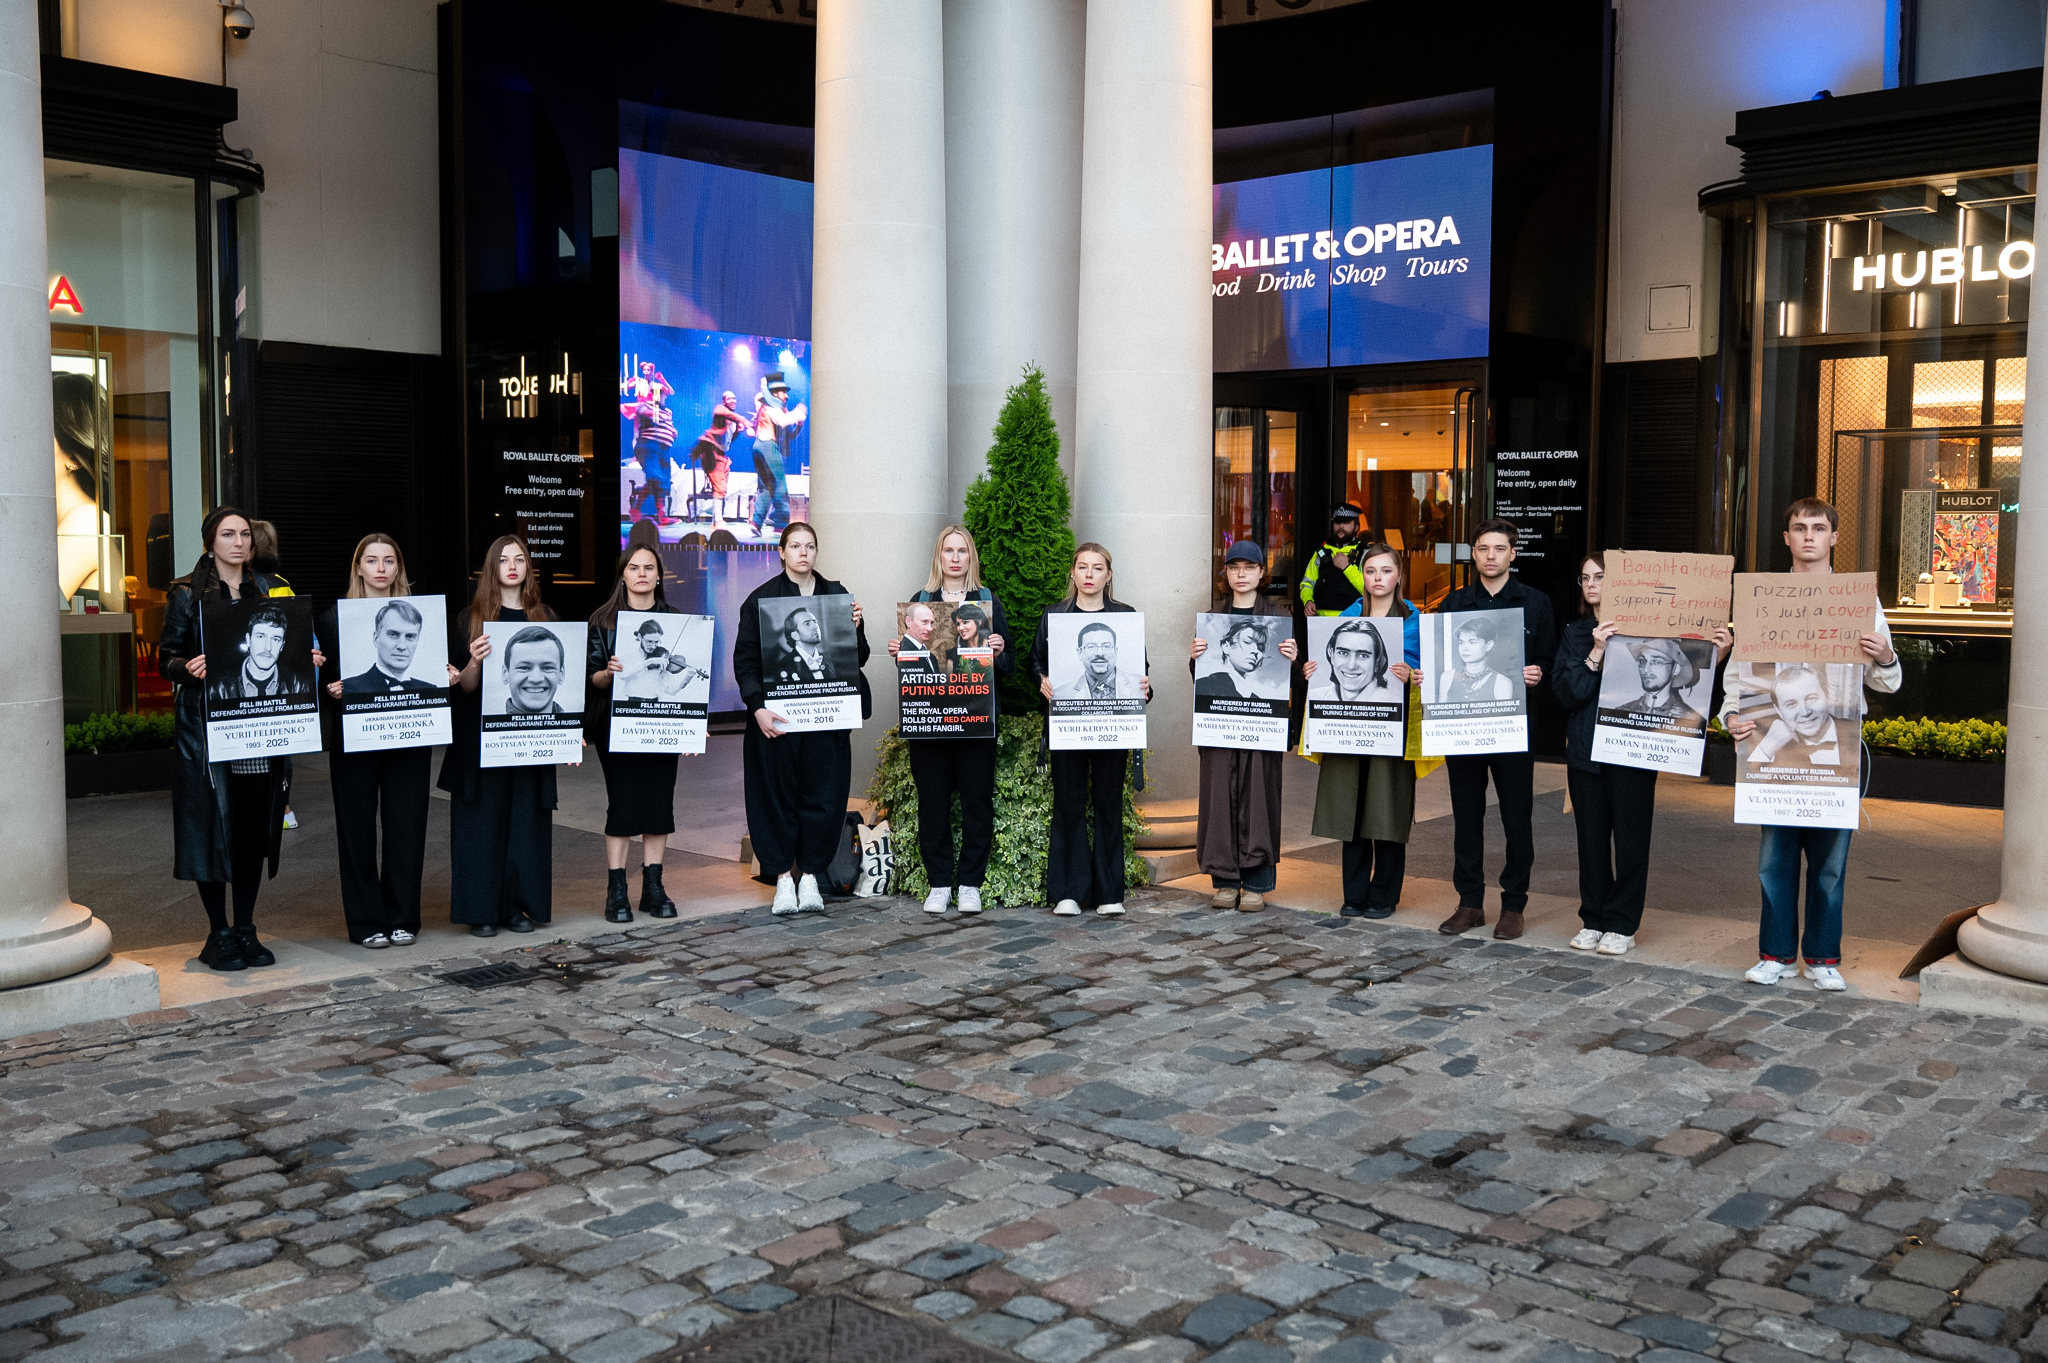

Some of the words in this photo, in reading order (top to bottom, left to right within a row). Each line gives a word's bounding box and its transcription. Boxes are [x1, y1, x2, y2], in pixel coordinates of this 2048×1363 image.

[1212, 233, 1309, 271] BALLET
[1312, 230, 1341, 260] &
[1344, 216, 1461, 256] OPERA
[1853, 241, 2035, 291] HUBLO
[1256, 269, 1315, 293] Drink
[1332, 263, 1387, 287] Shop
[1406, 257, 1469, 277] Tours
[49, 276, 84, 313] A
[503, 451, 527, 460] ROYAL
[528, 453, 553, 461] BALLET
[1497, 452, 1520, 460] ROYAL
[1521, 451, 1545, 459] BALLET
[528, 475, 562, 484] Welcome
[1515, 480, 1536, 488] entry,
[1538, 480, 1556, 488] open
[1559, 479, 1576, 488] daily
[505, 486, 522, 494] Free
[524, 487, 546, 496] entry,
[548, 489, 565, 497] open
[567, 488, 584, 497] daily
[1942, 497, 1993, 506] HUBLOT
[1623, 558, 1677, 578] Bought
[1680, 565, 1688, 575] a
[1693, 561, 1730, 579] ticket
[1754, 585, 1822, 597] ruzzian
[1828, 581, 1877, 595] culture
[1613, 596, 1662, 609] support
[1670, 596, 1729, 609] terrorism
[1756, 604, 1768, 618] is
[1779, 606, 1806, 618] just
[1828, 606, 1875, 618] cover
[1616, 611, 1660, 626] against
[1761, 625, 1790, 640] for
[1798, 628, 1861, 639] ruzzian
[901, 674, 947, 684] ARTISTS
[949, 673, 968, 683] DIE
[971, 673, 985, 682] BY
[902, 686, 945, 695] PUTIN'S
[948, 685, 989, 694] BOMBS
[1652, 715, 1675, 724] BATTLE
[362, 724, 385, 732] IHOR
[388, 720, 434, 729] VORONKA
[1470, 726, 1523, 735] KOZHUSHKO
[225, 730, 251, 740] YURII
[254, 726, 305, 737] FELIPENKO
[399, 731, 421, 739] 2024
[266, 738, 289, 747] 2025
[485, 740, 527, 748] ROSTYSLAV
[1605, 738, 1639, 748] ROMAN
[1642, 743, 1690, 755] BARVINOK
[1647, 754, 1669, 763] 2022
[1749, 796, 1808, 806] VLADYSLAV
[1796, 809, 1821, 818] 2025
